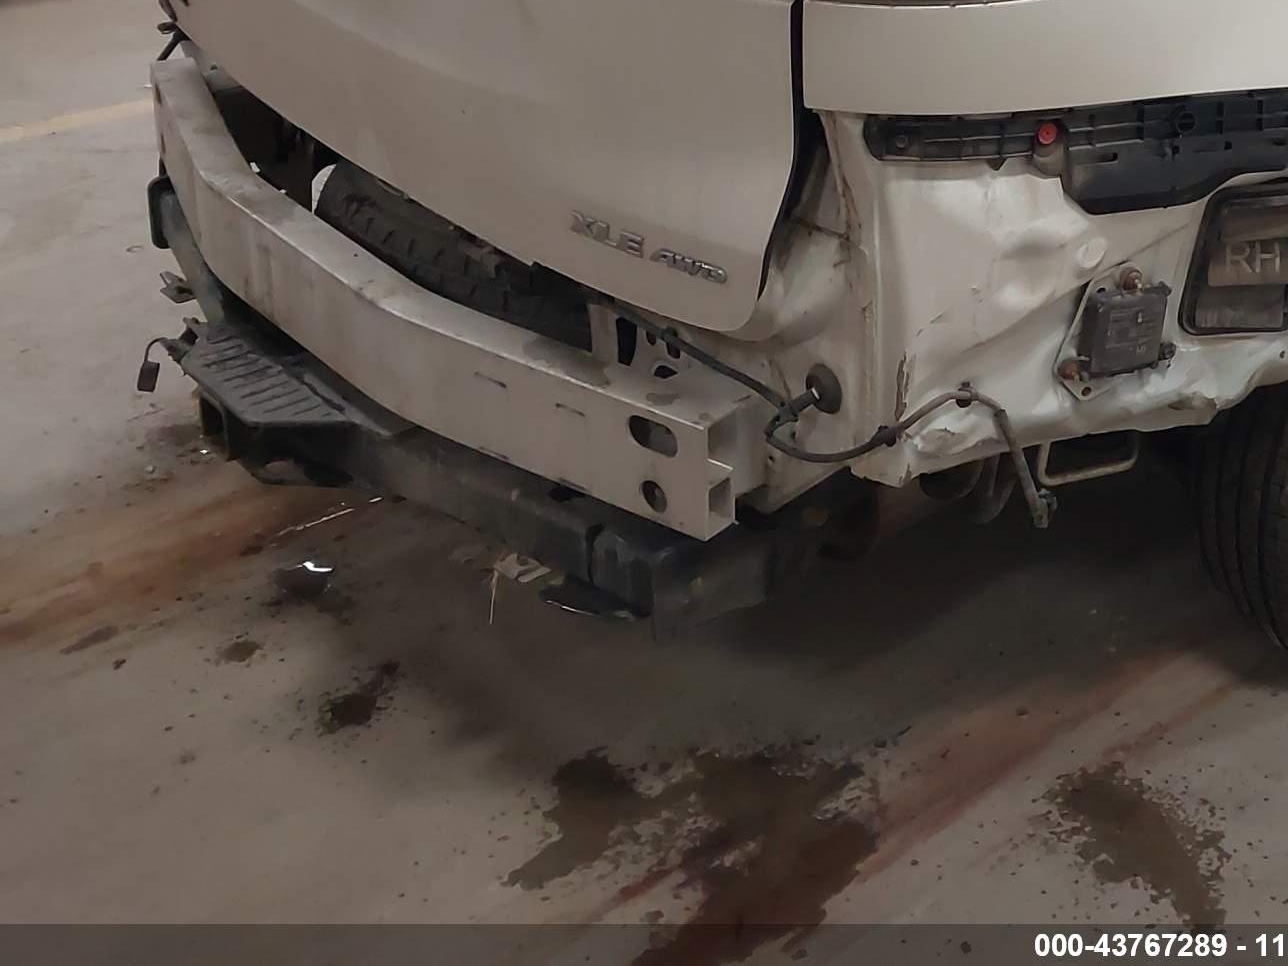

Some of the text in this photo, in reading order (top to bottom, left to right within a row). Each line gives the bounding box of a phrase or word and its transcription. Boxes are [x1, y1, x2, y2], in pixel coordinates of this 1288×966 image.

[570, 210, 728, 284] XLE AWD
[1225, 241, 1281, 274] RH
